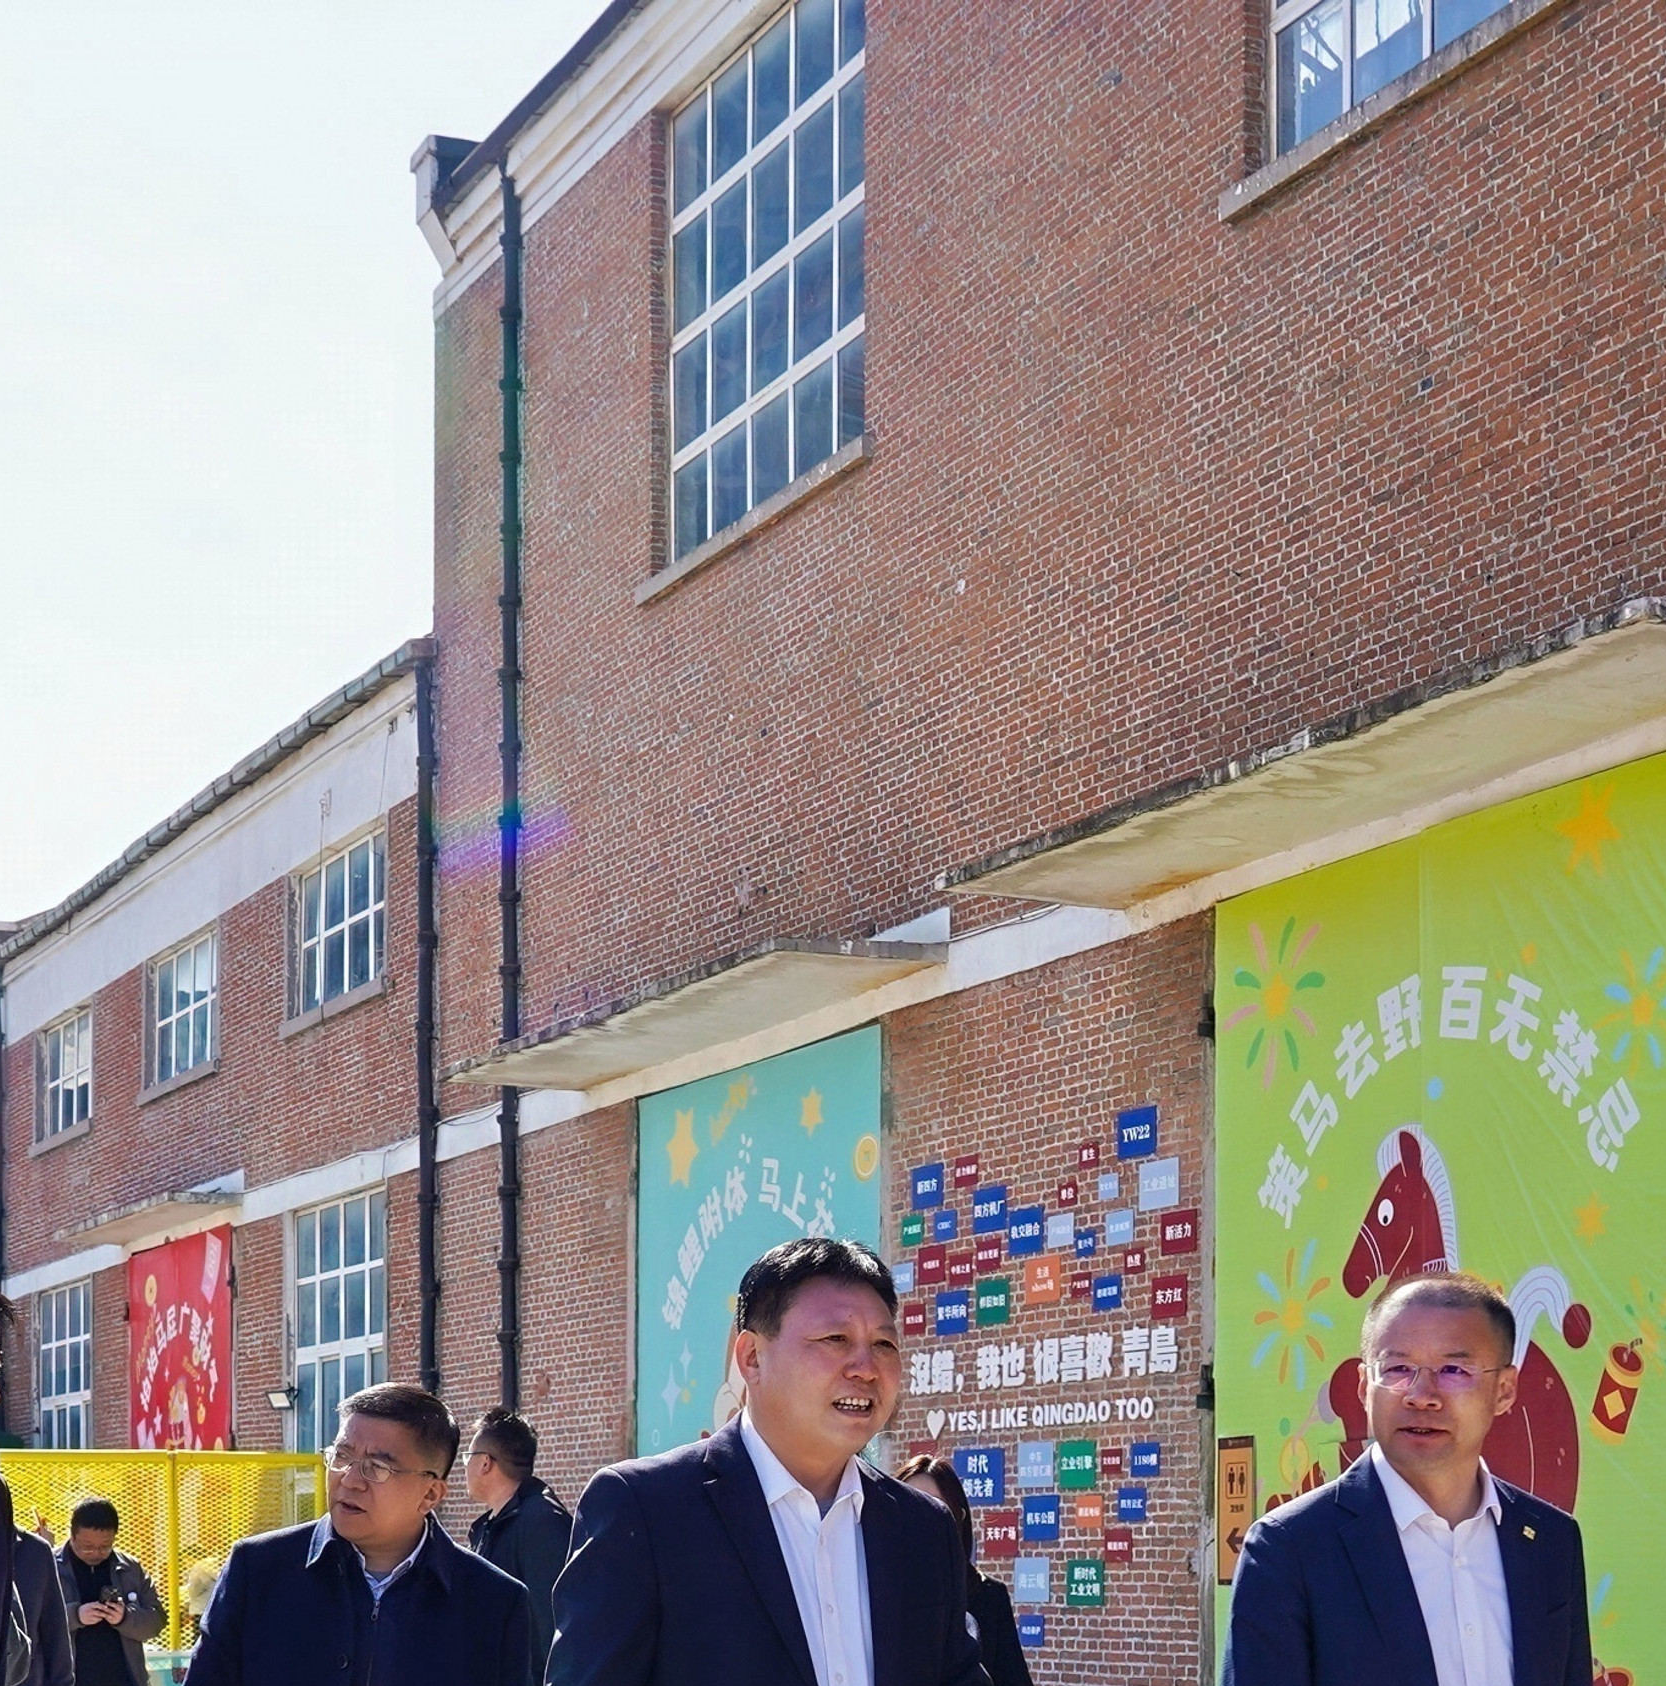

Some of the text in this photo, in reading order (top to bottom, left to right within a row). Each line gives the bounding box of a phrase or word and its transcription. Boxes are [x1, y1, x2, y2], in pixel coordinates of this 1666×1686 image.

[1122, 1124, 1151, 1143] YW22
[917, 1177, 938, 1195] 新四方
[974, 1200, 1006, 1218] 四方机厂
[1165, 1223, 1192, 1241] 新活力
[1127, 1253, 1141, 1267] 热度
[1036, 1266, 1050, 1278] 生活
[1155, 1288, 1183, 1304] 东方红
[937, 1303, 967, 1321] 繁华所向
[991, 1405, 1028, 1429] LIKE
[1032, 1400, 1111, 1428] QINGDAO
[1115, 1396, 1155, 1420] TOO
[967, 1454, 989, 1474] 时代
[1026, 1511, 1055, 1525] 机车公园
[986, 1526, 1017, 1541] 天车广场
[1074, 1567, 1097, 1581] 新时代
[1070, 1583, 1101, 1597] 工业文明
